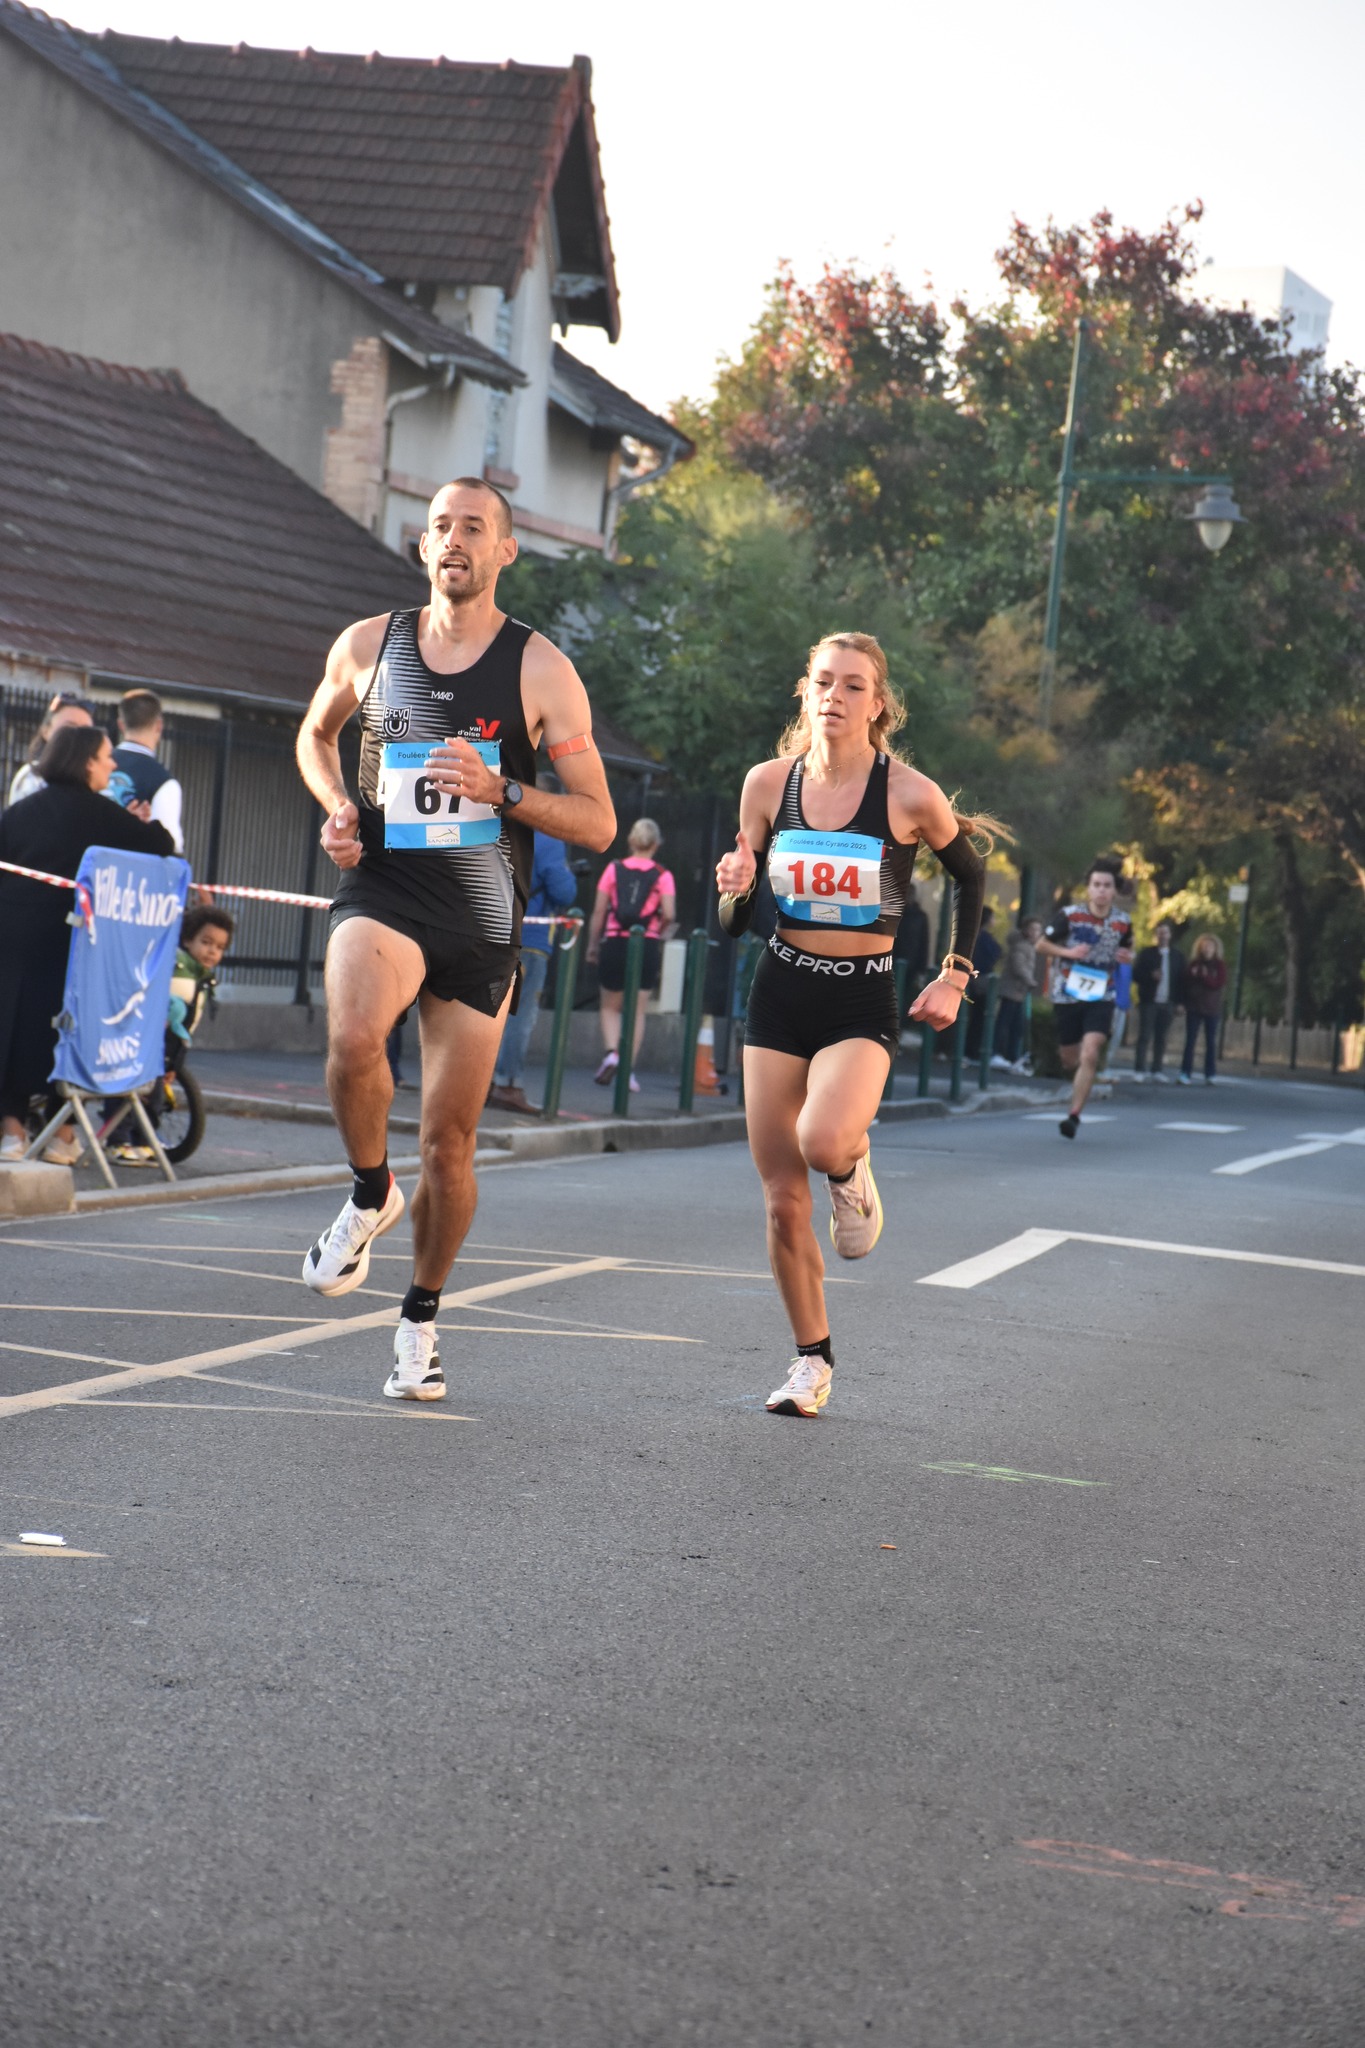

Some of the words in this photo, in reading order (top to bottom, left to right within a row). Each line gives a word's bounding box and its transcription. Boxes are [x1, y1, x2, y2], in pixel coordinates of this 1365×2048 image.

[457, 730, 481, 738] d'oise
[397, 751, 425, 759] Foulées
[415, 775, 462, 816] 67
[789, 838, 814, 846] Foulées
[825, 840, 849, 848] Cyrano
[850, 842, 867, 850] 2025
[787, 860, 862, 899] 184
[121, 870, 136, 924] de
[795, 954, 856, 976] PRO
[1079, 976, 1096, 991] 77
